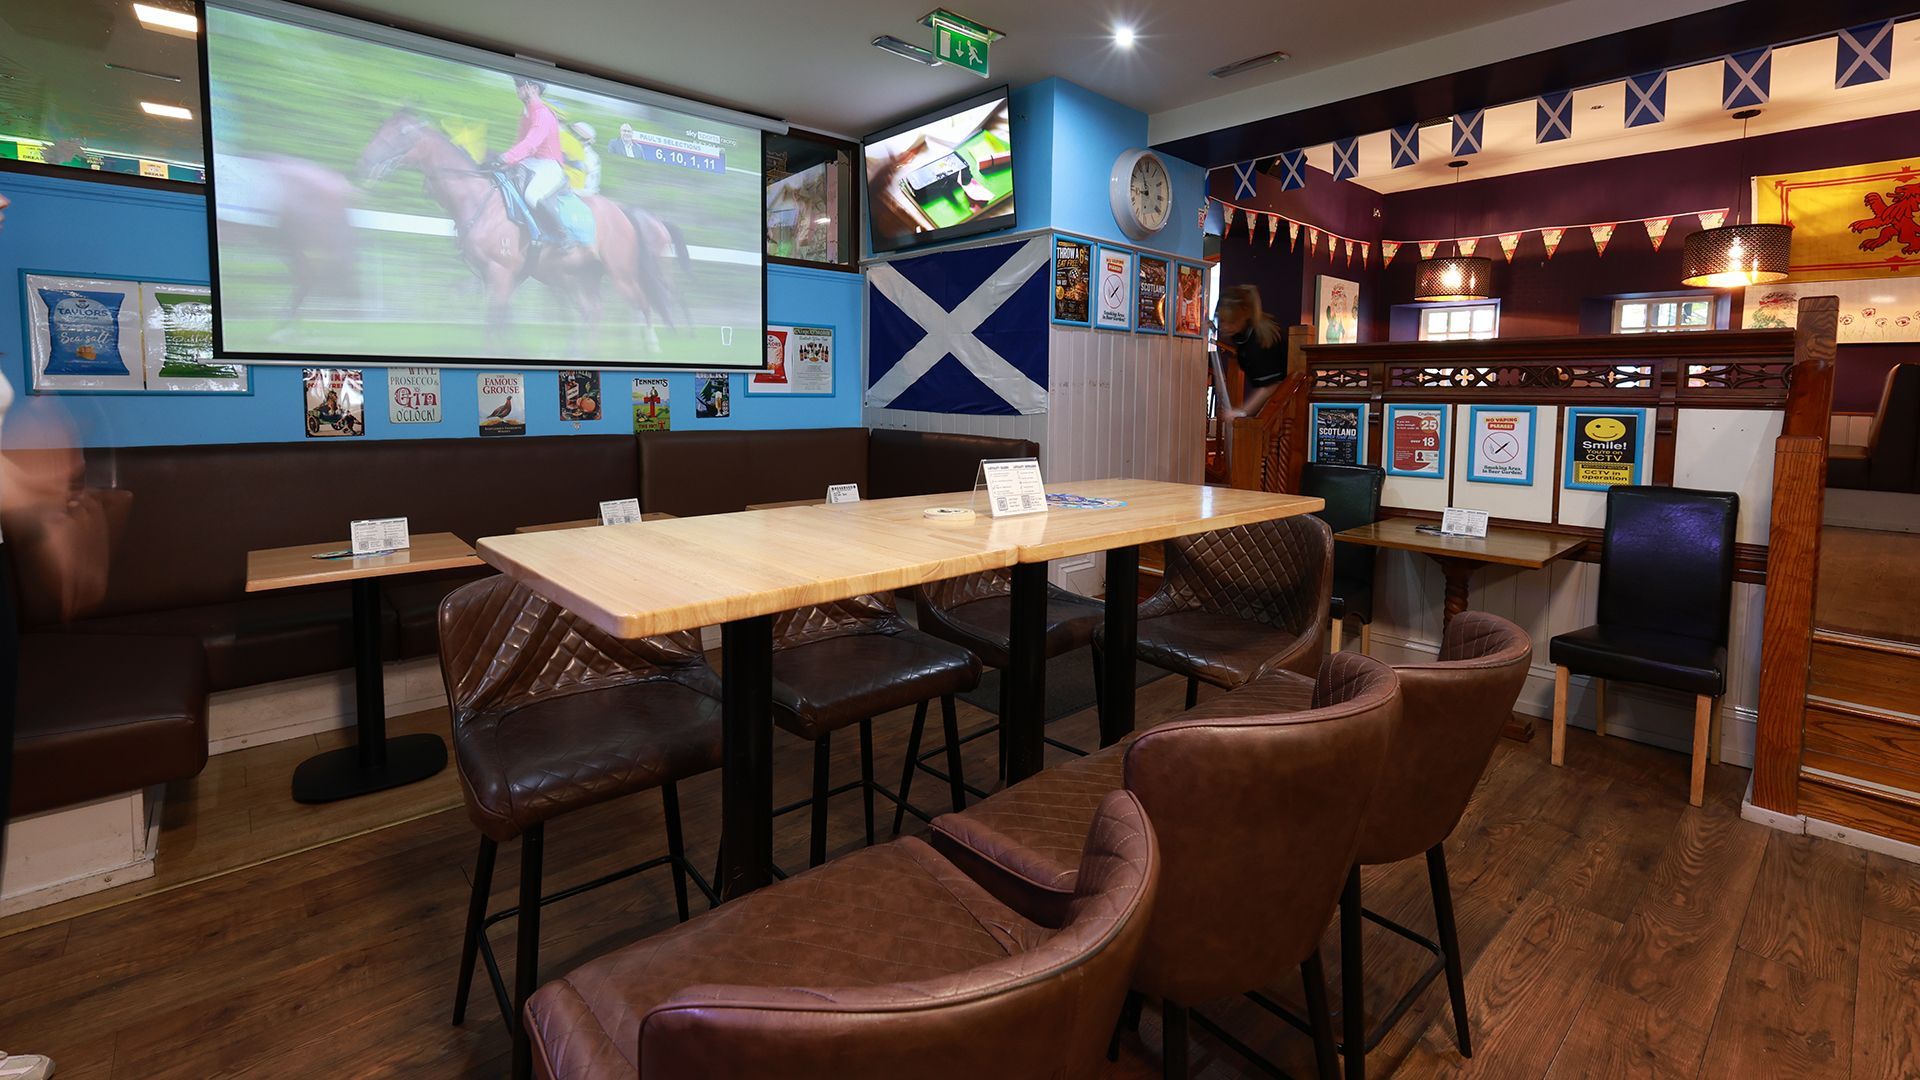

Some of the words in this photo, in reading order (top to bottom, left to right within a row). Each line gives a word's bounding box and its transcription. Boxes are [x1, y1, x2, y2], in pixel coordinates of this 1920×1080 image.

[640, 133, 662, 143] PAUL'S
[685, 129, 697, 138] sky
[655, 148, 666, 162] 6,
[670, 152, 687, 167] 10,
[690, 155, 700, 168] 1,
[703, 158, 715, 170] 11
[57, 308, 109, 317] TAYLORS
[60, 332, 82, 344] Sea
[84, 330, 111, 344] salt
[409, 367, 437, 375] WINE
[390, 377, 433, 385] PROSECCO
[484, 378, 518, 386] FAMOUS
[482, 386, 520, 394] GROUSE
[395, 387, 437, 409] Gin
[396, 408, 435, 421] O'CLOCK!
[1421, 420, 1437, 430] 25
[1319, 427, 1357, 436] SCOTLAND
[1423, 437, 1435, 447] 18
[1583, 441, 1627, 450] Smile!
